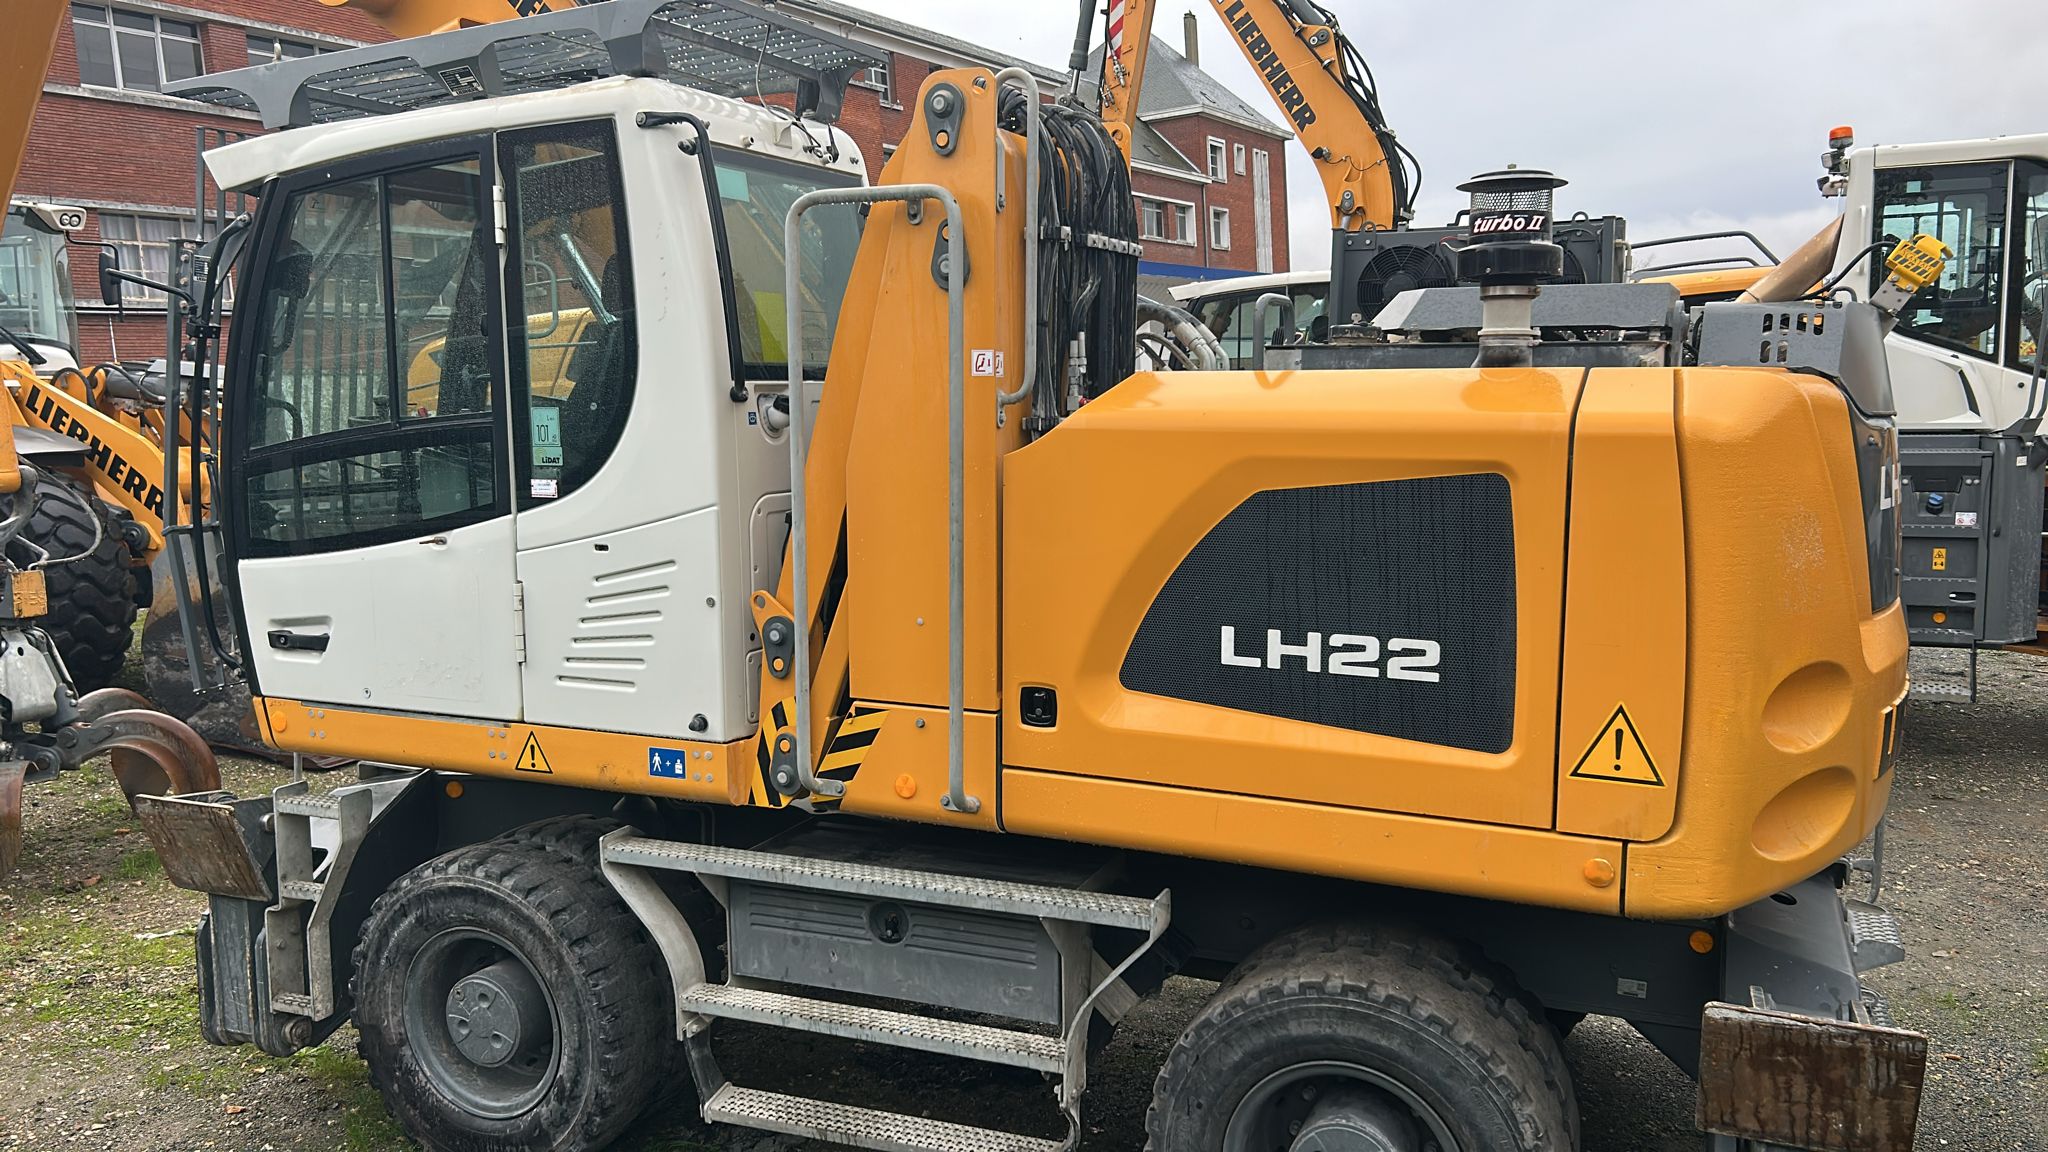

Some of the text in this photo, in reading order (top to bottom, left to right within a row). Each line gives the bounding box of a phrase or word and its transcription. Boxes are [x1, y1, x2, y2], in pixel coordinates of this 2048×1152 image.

[1224, 0, 1317, 133] LIEBHERR
[1473, 213, 1526, 235] turbo
[536, 424, 549, 442] 101
[1221, 625, 1441, 683] LH22
